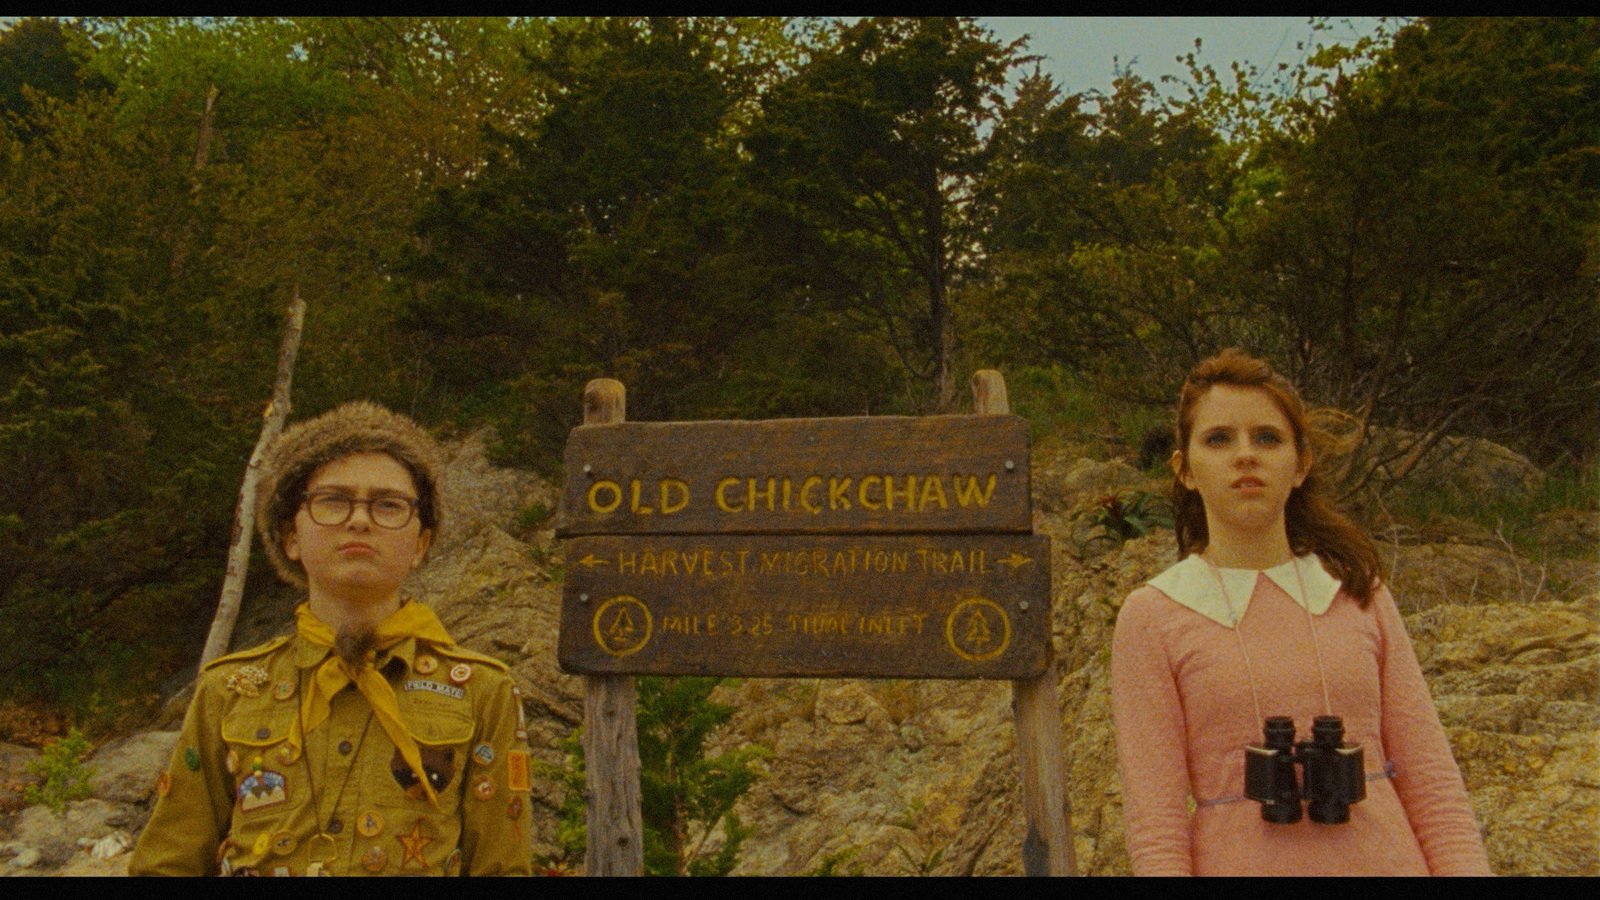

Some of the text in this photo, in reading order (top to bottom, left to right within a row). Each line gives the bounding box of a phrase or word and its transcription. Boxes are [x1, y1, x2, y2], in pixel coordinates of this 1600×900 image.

[587, 473, 998, 515] OLD CHICKCHAW
[617, 548, 992, 577] HARVEST MIGRATION TRAIL
[660, 614, 719, 637] MILE
[858, 612, 930, 636] INLET
